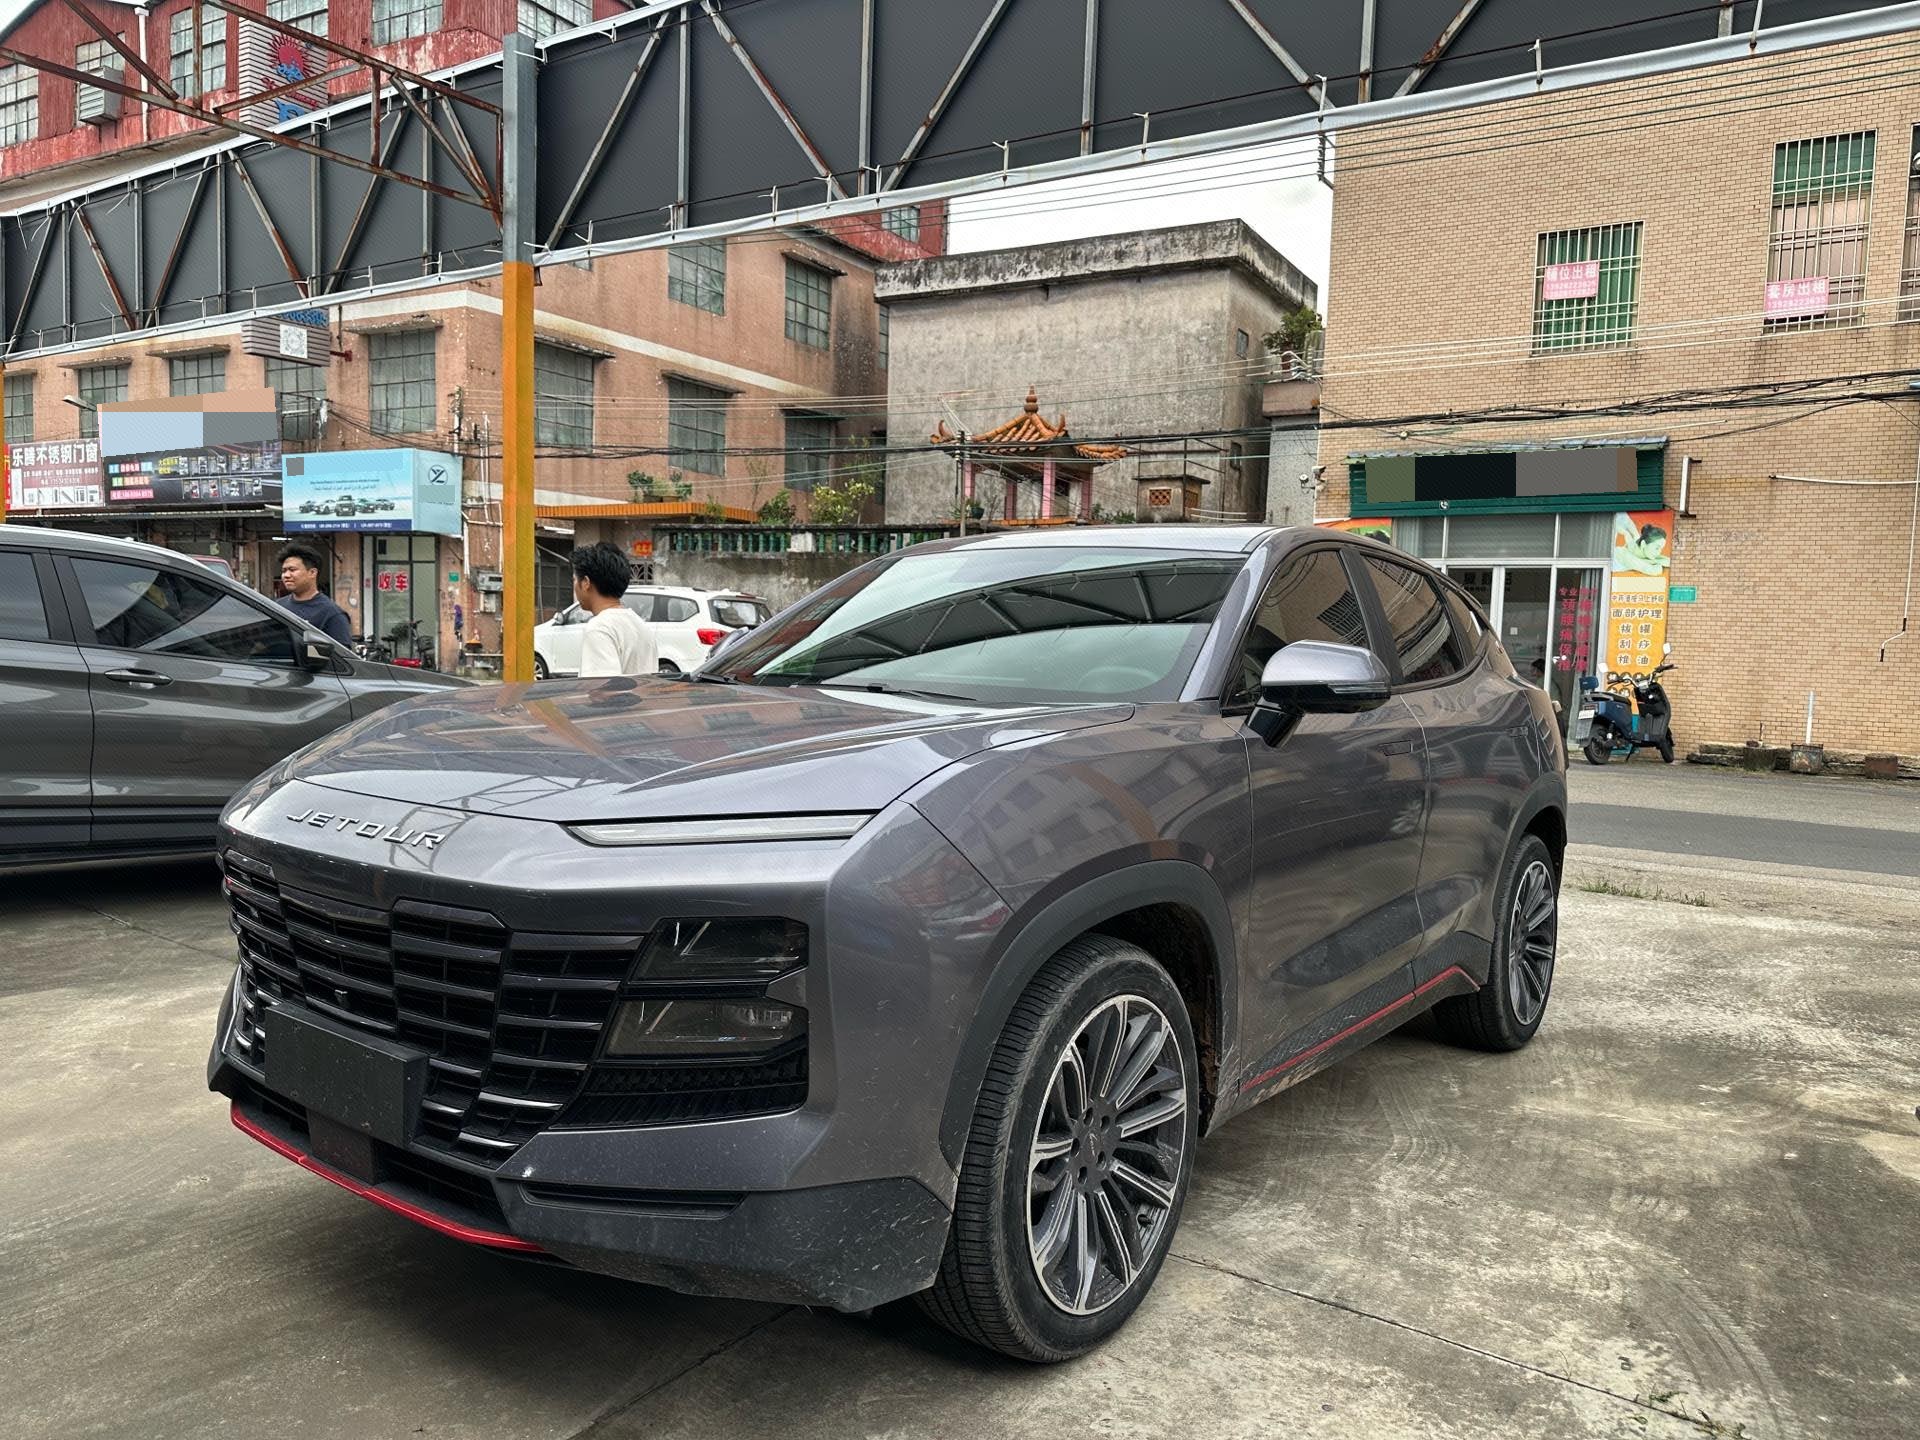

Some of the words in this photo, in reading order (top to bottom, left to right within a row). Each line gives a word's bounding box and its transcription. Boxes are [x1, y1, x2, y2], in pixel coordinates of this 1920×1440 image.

[378, 571, 408, 592] 收车
[1612, 608, 1662, 619] 面部护理
[1618, 639, 1650, 650] 刮痧
[286, 808, 447, 849] JETOUR
